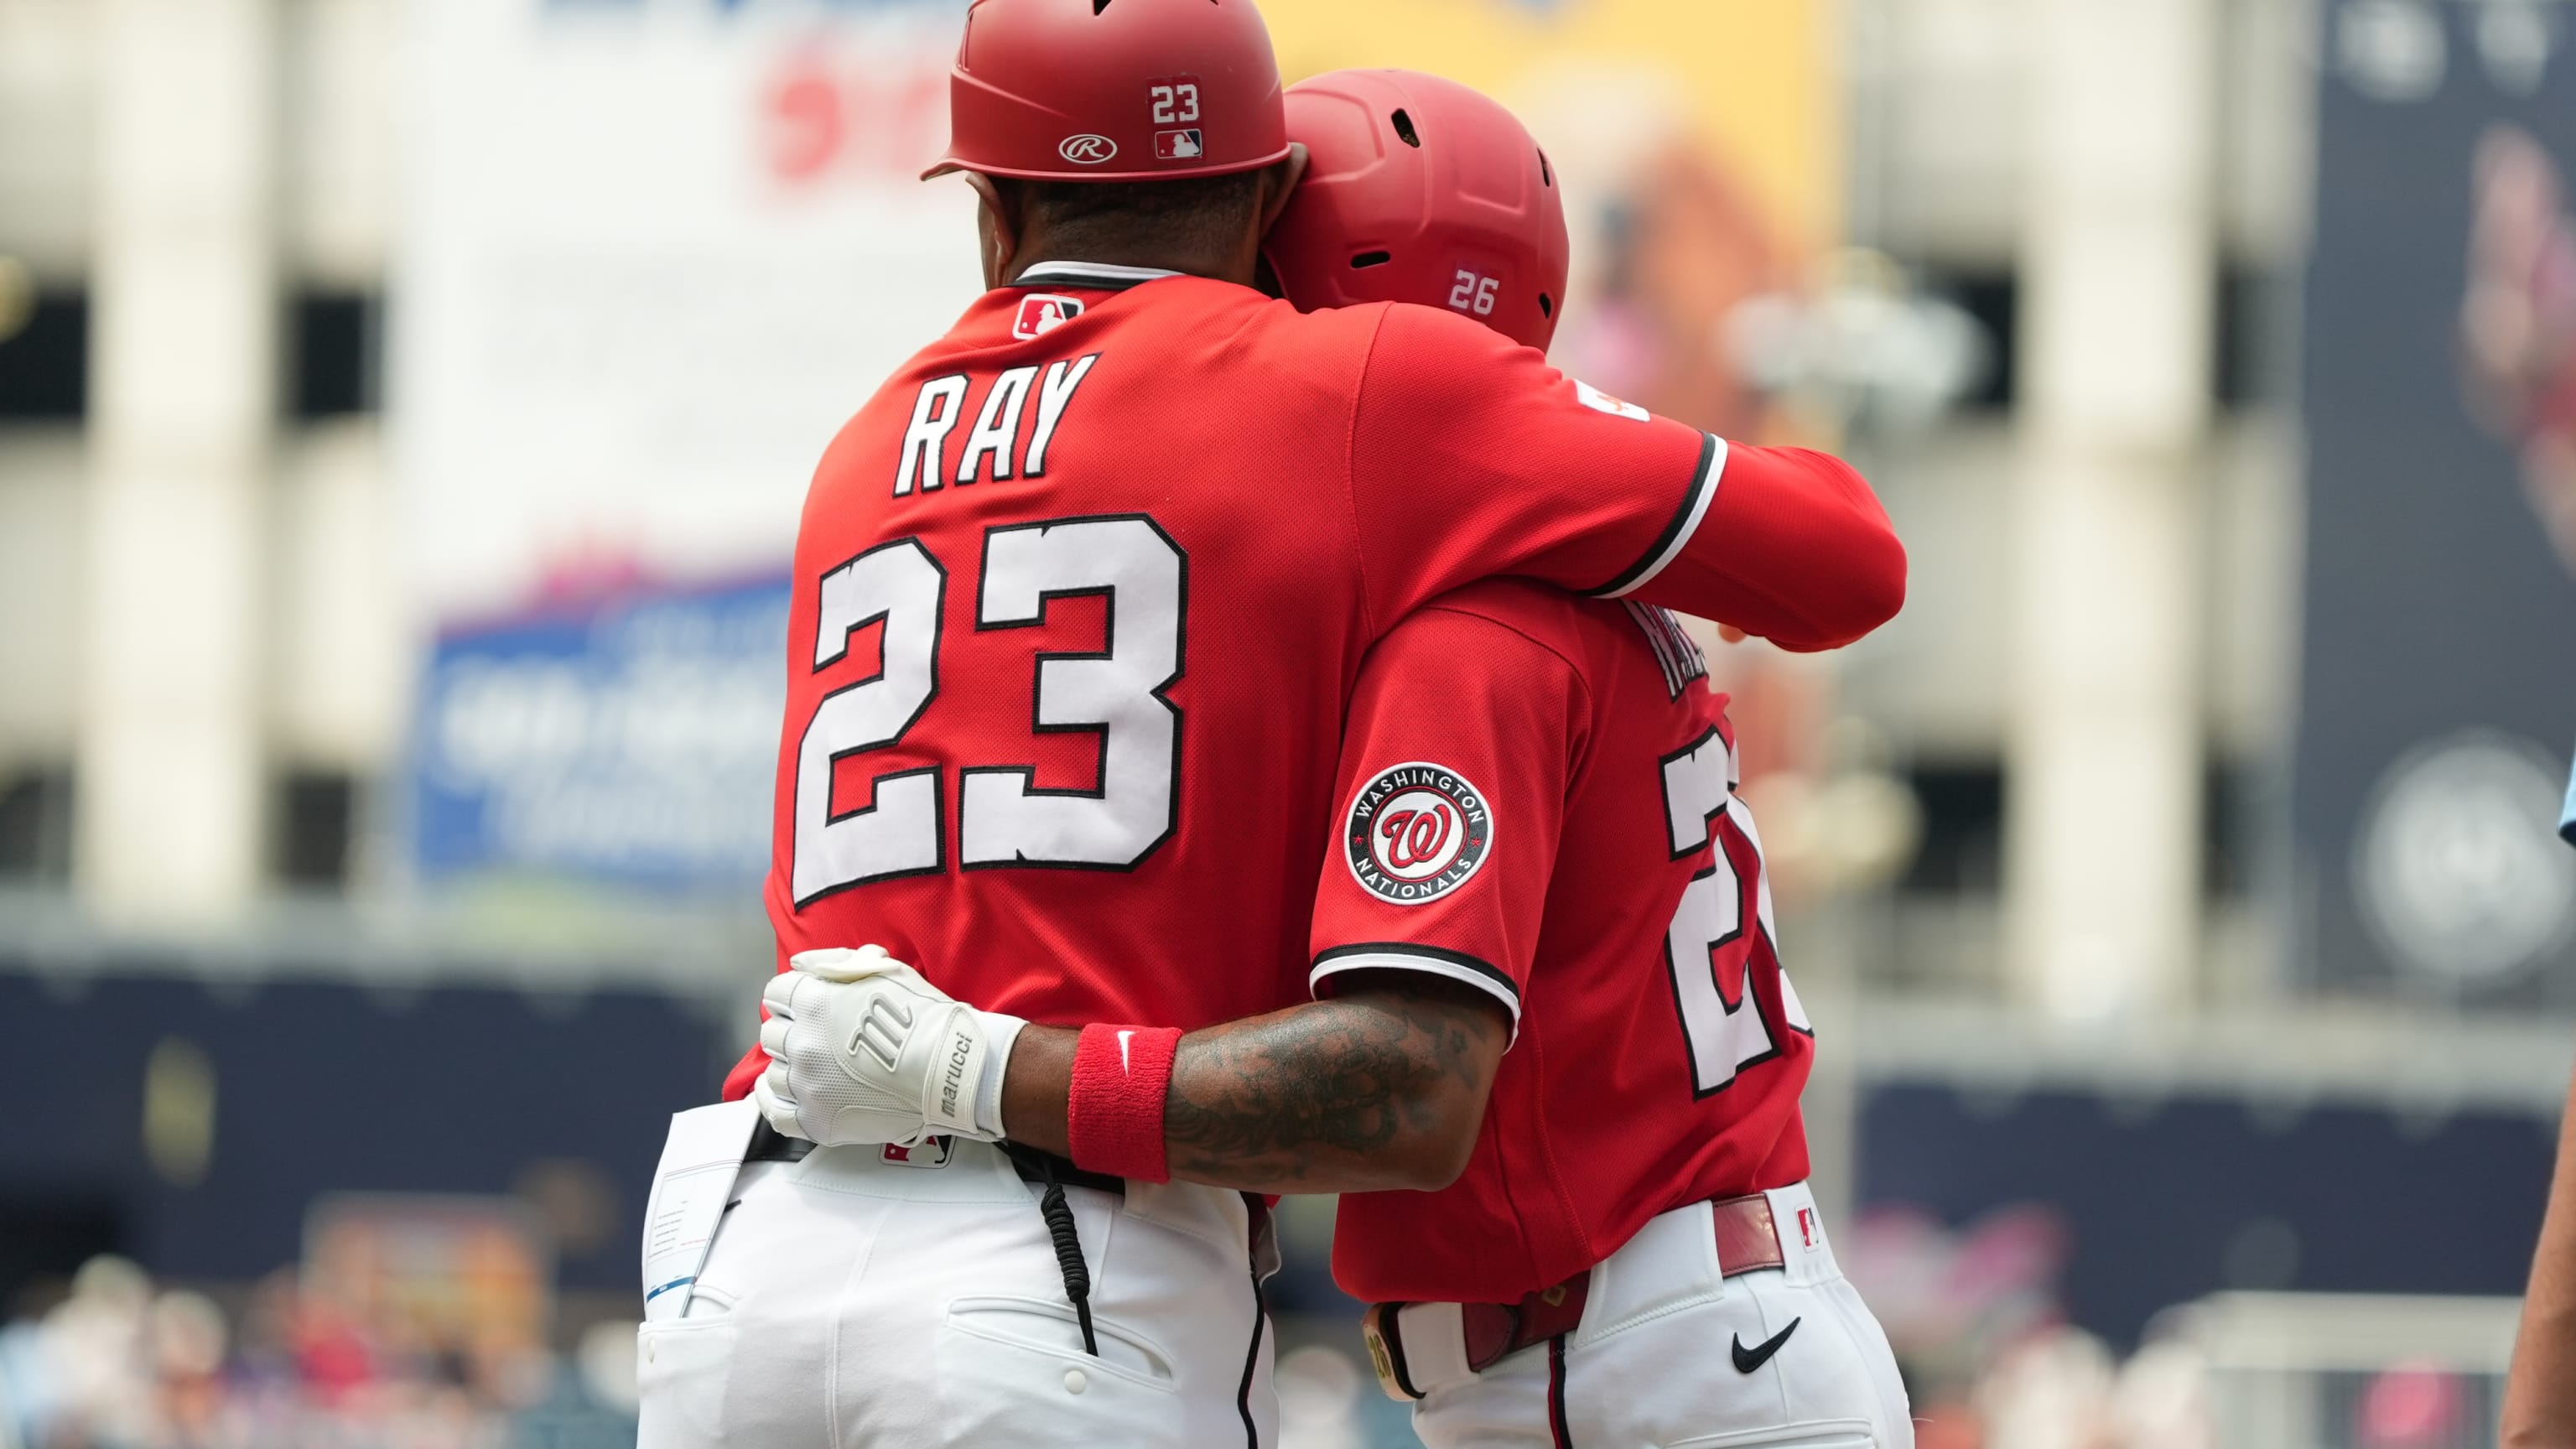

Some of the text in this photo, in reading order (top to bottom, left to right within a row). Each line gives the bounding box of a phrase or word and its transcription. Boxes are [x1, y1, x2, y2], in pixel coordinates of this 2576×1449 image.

[1151, 84, 1199, 123] 23
[1448, 269, 1499, 315] 26
[892, 351, 1104, 499] RAY
[792, 512, 1188, 914] 23
[1355, 769, 1484, 823] WASHINGTON
[1381, 803, 1452, 869] W
[1356, 857, 1472, 898] NATIONALS
[940, 1031, 973, 1119] marucci
